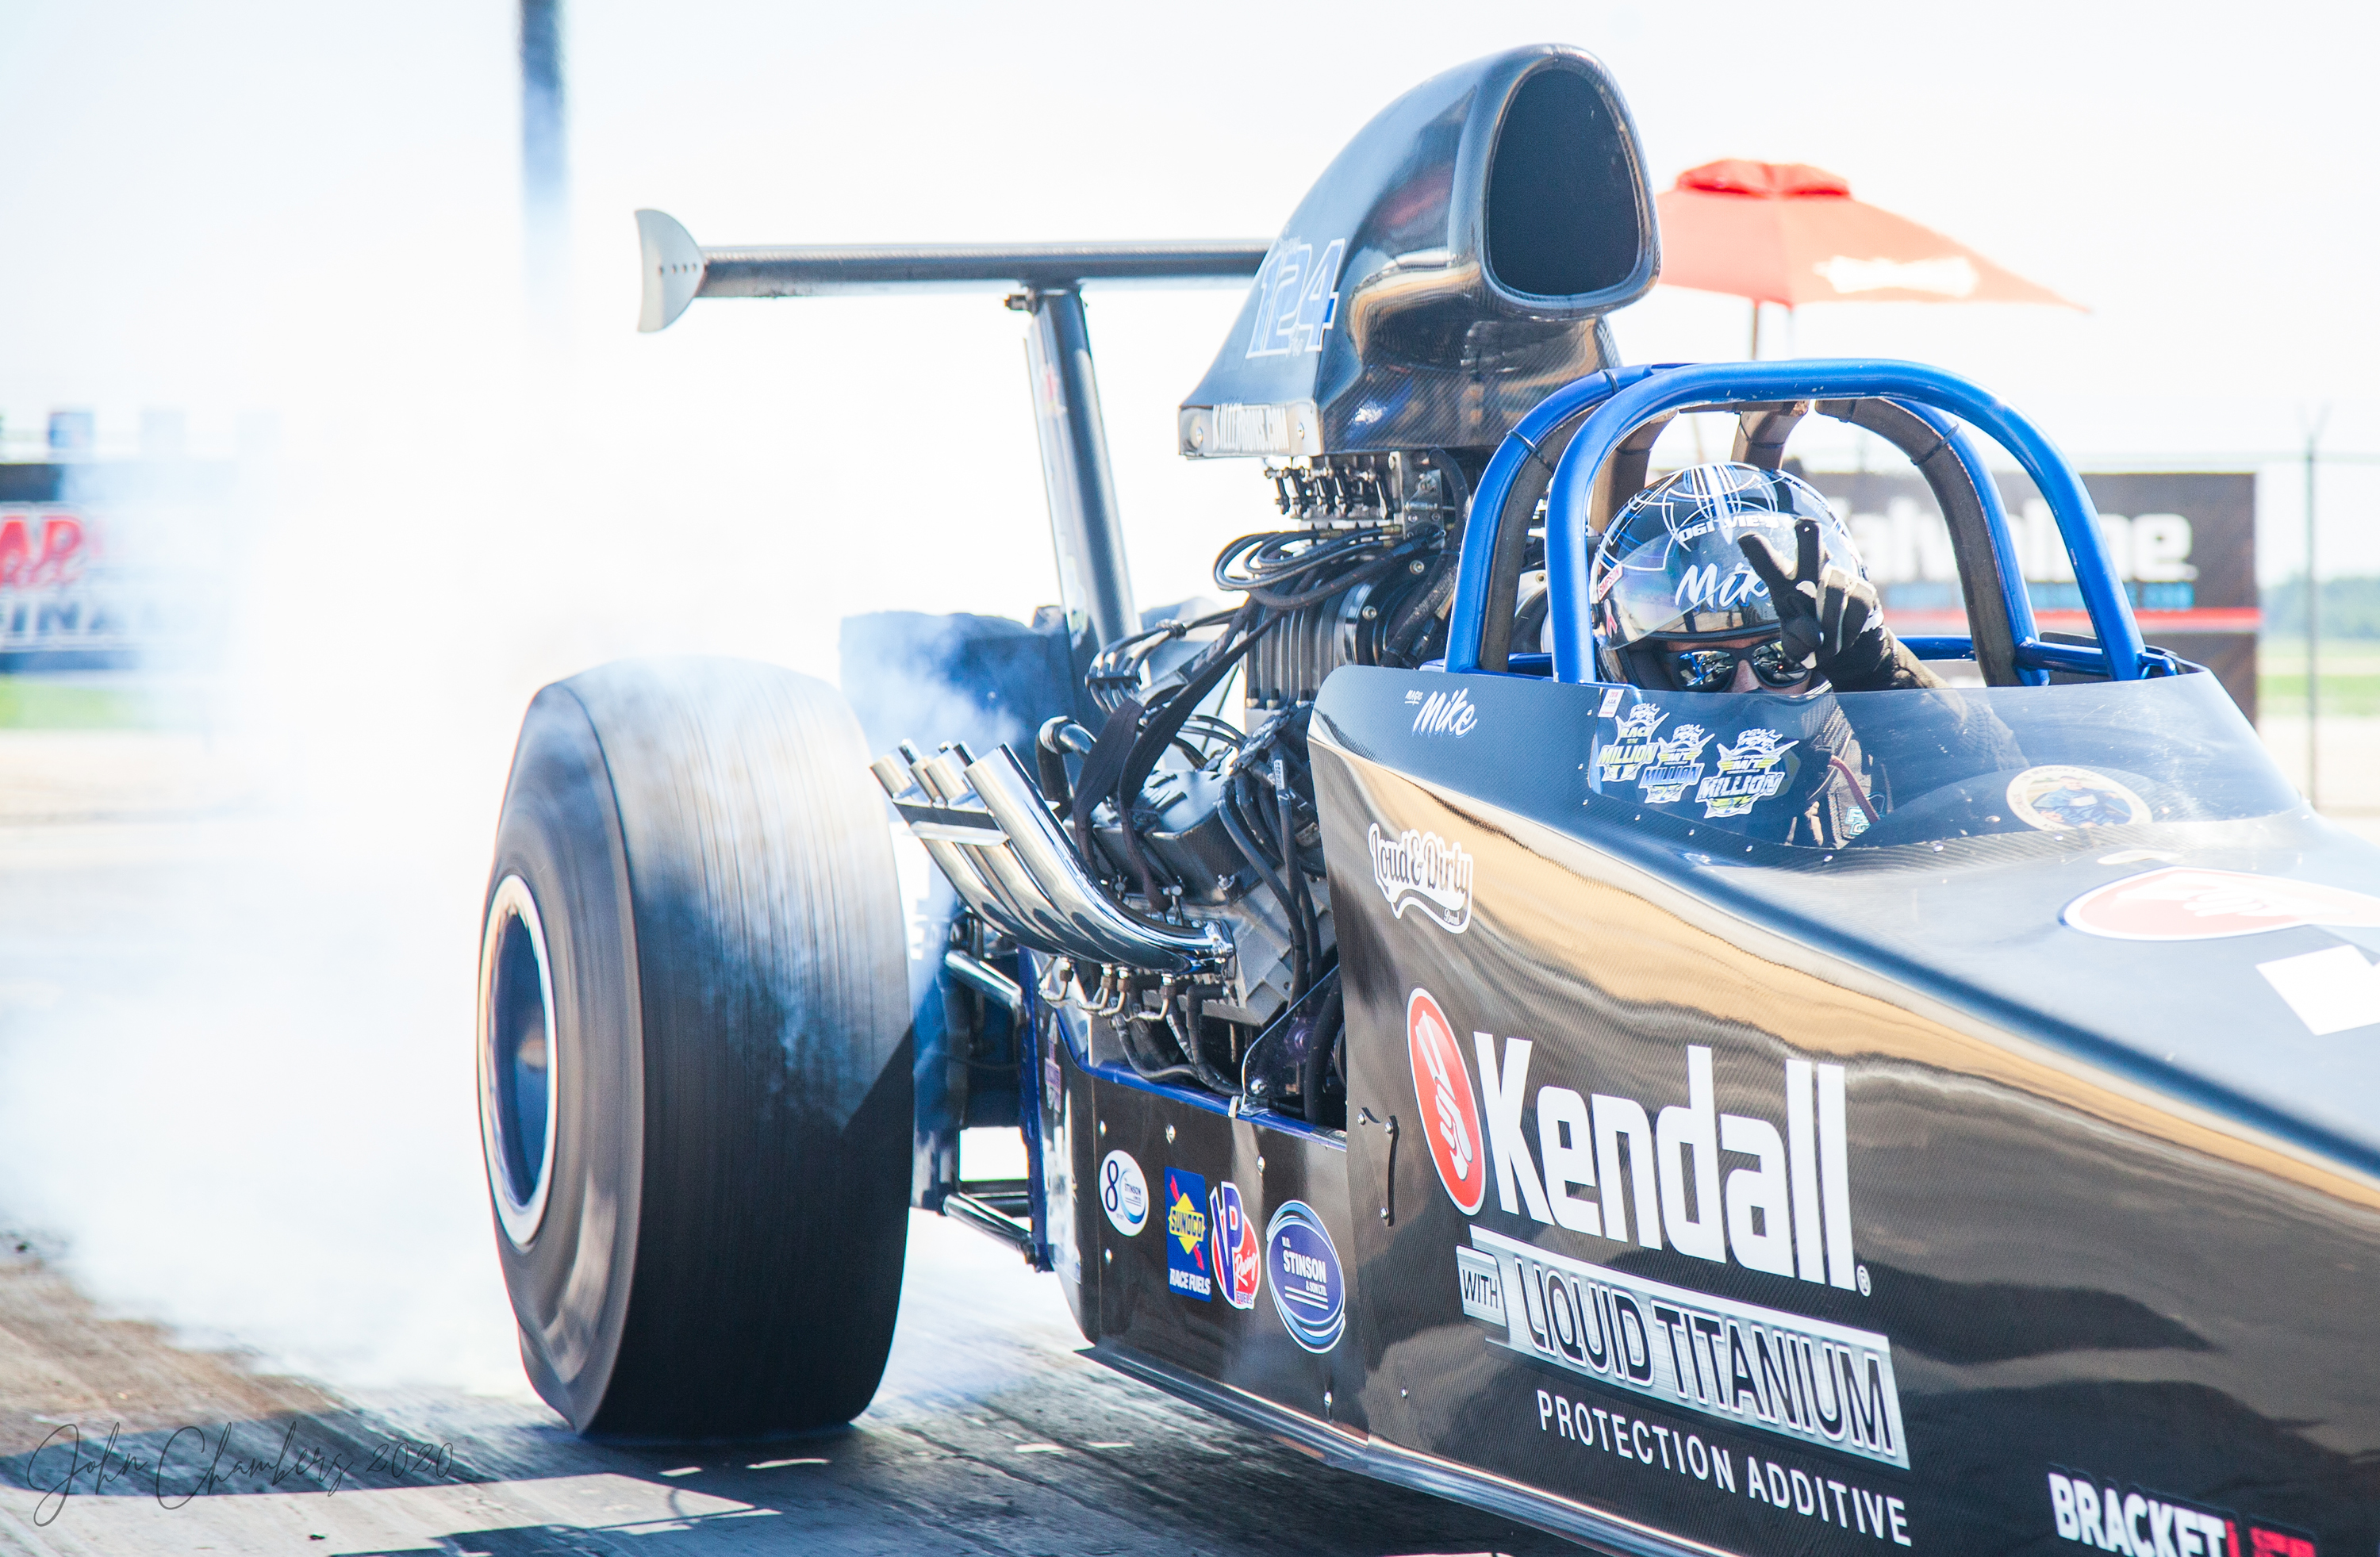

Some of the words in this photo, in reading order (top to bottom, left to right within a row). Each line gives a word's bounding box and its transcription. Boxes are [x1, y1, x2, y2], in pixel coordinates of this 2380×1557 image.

[1245, 238, 1346, 359] 124
[1411, 687, 1478, 738] Mike
[1619, 726, 1653, 738] RACE
[1599, 744, 1660, 765] MILLION
[1641, 765, 1701, 785] MILLION
[1696, 773, 1782, 800] MILLION
[1371, 830, 1410, 895] Loud
[1424, 838, 1471, 899] Dirty
[1474, 1031, 1857, 1291] Kendall
[1170, 1208, 1203, 1241] SUNOCO
[1211, 1183, 1244, 1302] VP
[1169, 1268, 1188, 1290] RACE
[1188, 1274, 1211, 1296] FUELS
[1235, 1249, 1258, 1288] Racing
[1283, 1249, 1327, 1284] STINSON
[1236, 1291, 1253, 1305] FUELS
[1463, 1268, 1499, 1310] WITH
[1514, 1257, 1655, 1388] LIQUID
[1652, 1299, 1897, 1458] TITANIUM
[1537, 1390, 1736, 1494] PROTECTION
[1749, 1457, 1912, 1547] ADDITIVE
